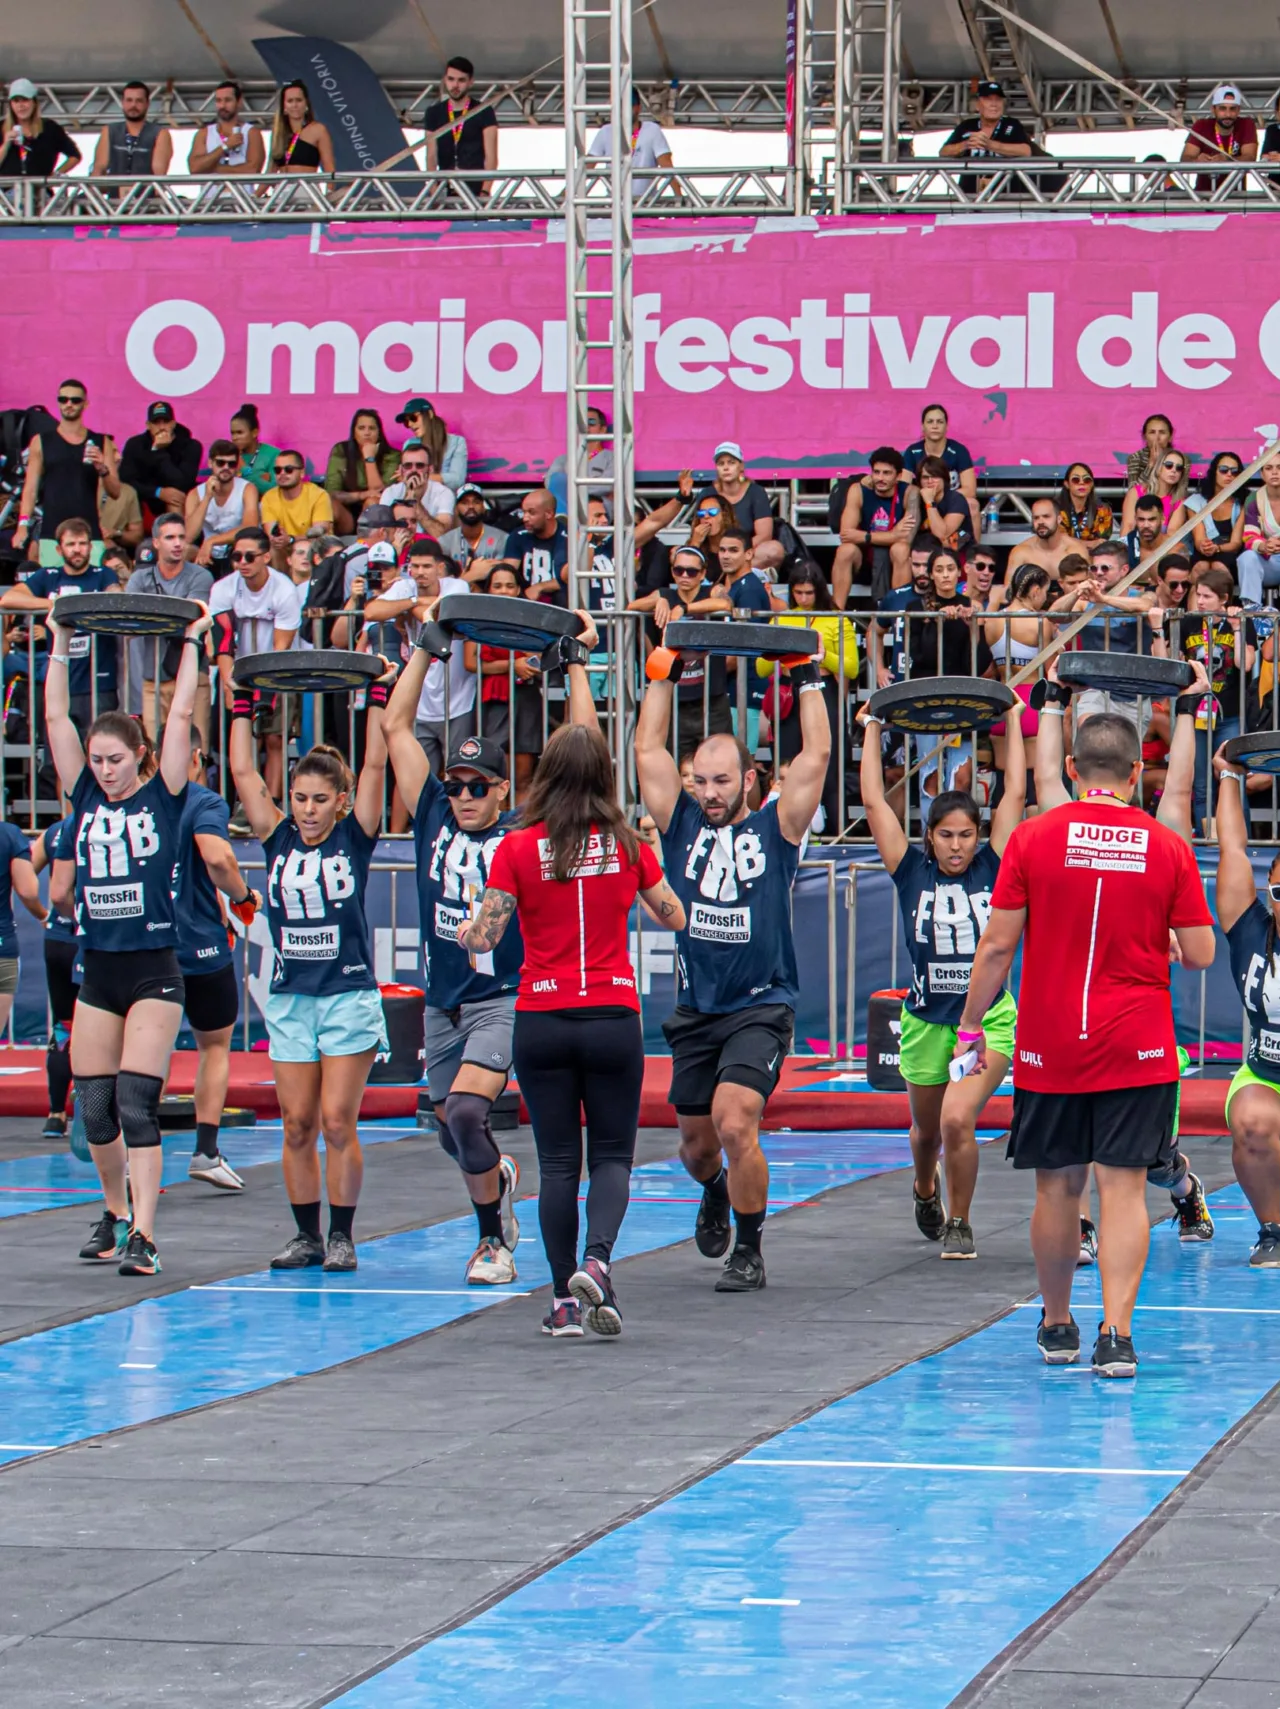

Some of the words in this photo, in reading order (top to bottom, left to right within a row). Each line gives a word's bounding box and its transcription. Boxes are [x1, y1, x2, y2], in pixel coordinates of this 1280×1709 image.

[309, 52, 349, 113] VITÓRIA
[125, 299, 225, 397] O
[631, 292, 1055, 392] festival
[1076, 292, 1237, 390] de
[75, 804, 161, 879] ERB
[1074, 825, 1143, 845] JUDGE
[1100, 851, 1119, 859] ROCK
[1121, 853, 1147, 861] BRASIL
[267, 847, 356, 920] ERB
[90, 889, 138, 905] CrossFit
[696, 909, 746, 928] CrossFit
[288, 931, 335, 946] CrossFit
[935, 967, 972, 981] Cross
[532, 979, 557, 993] WILL
[1020, 1050, 1043, 1066] WILL
[1137, 1047, 1165, 1060] broad
